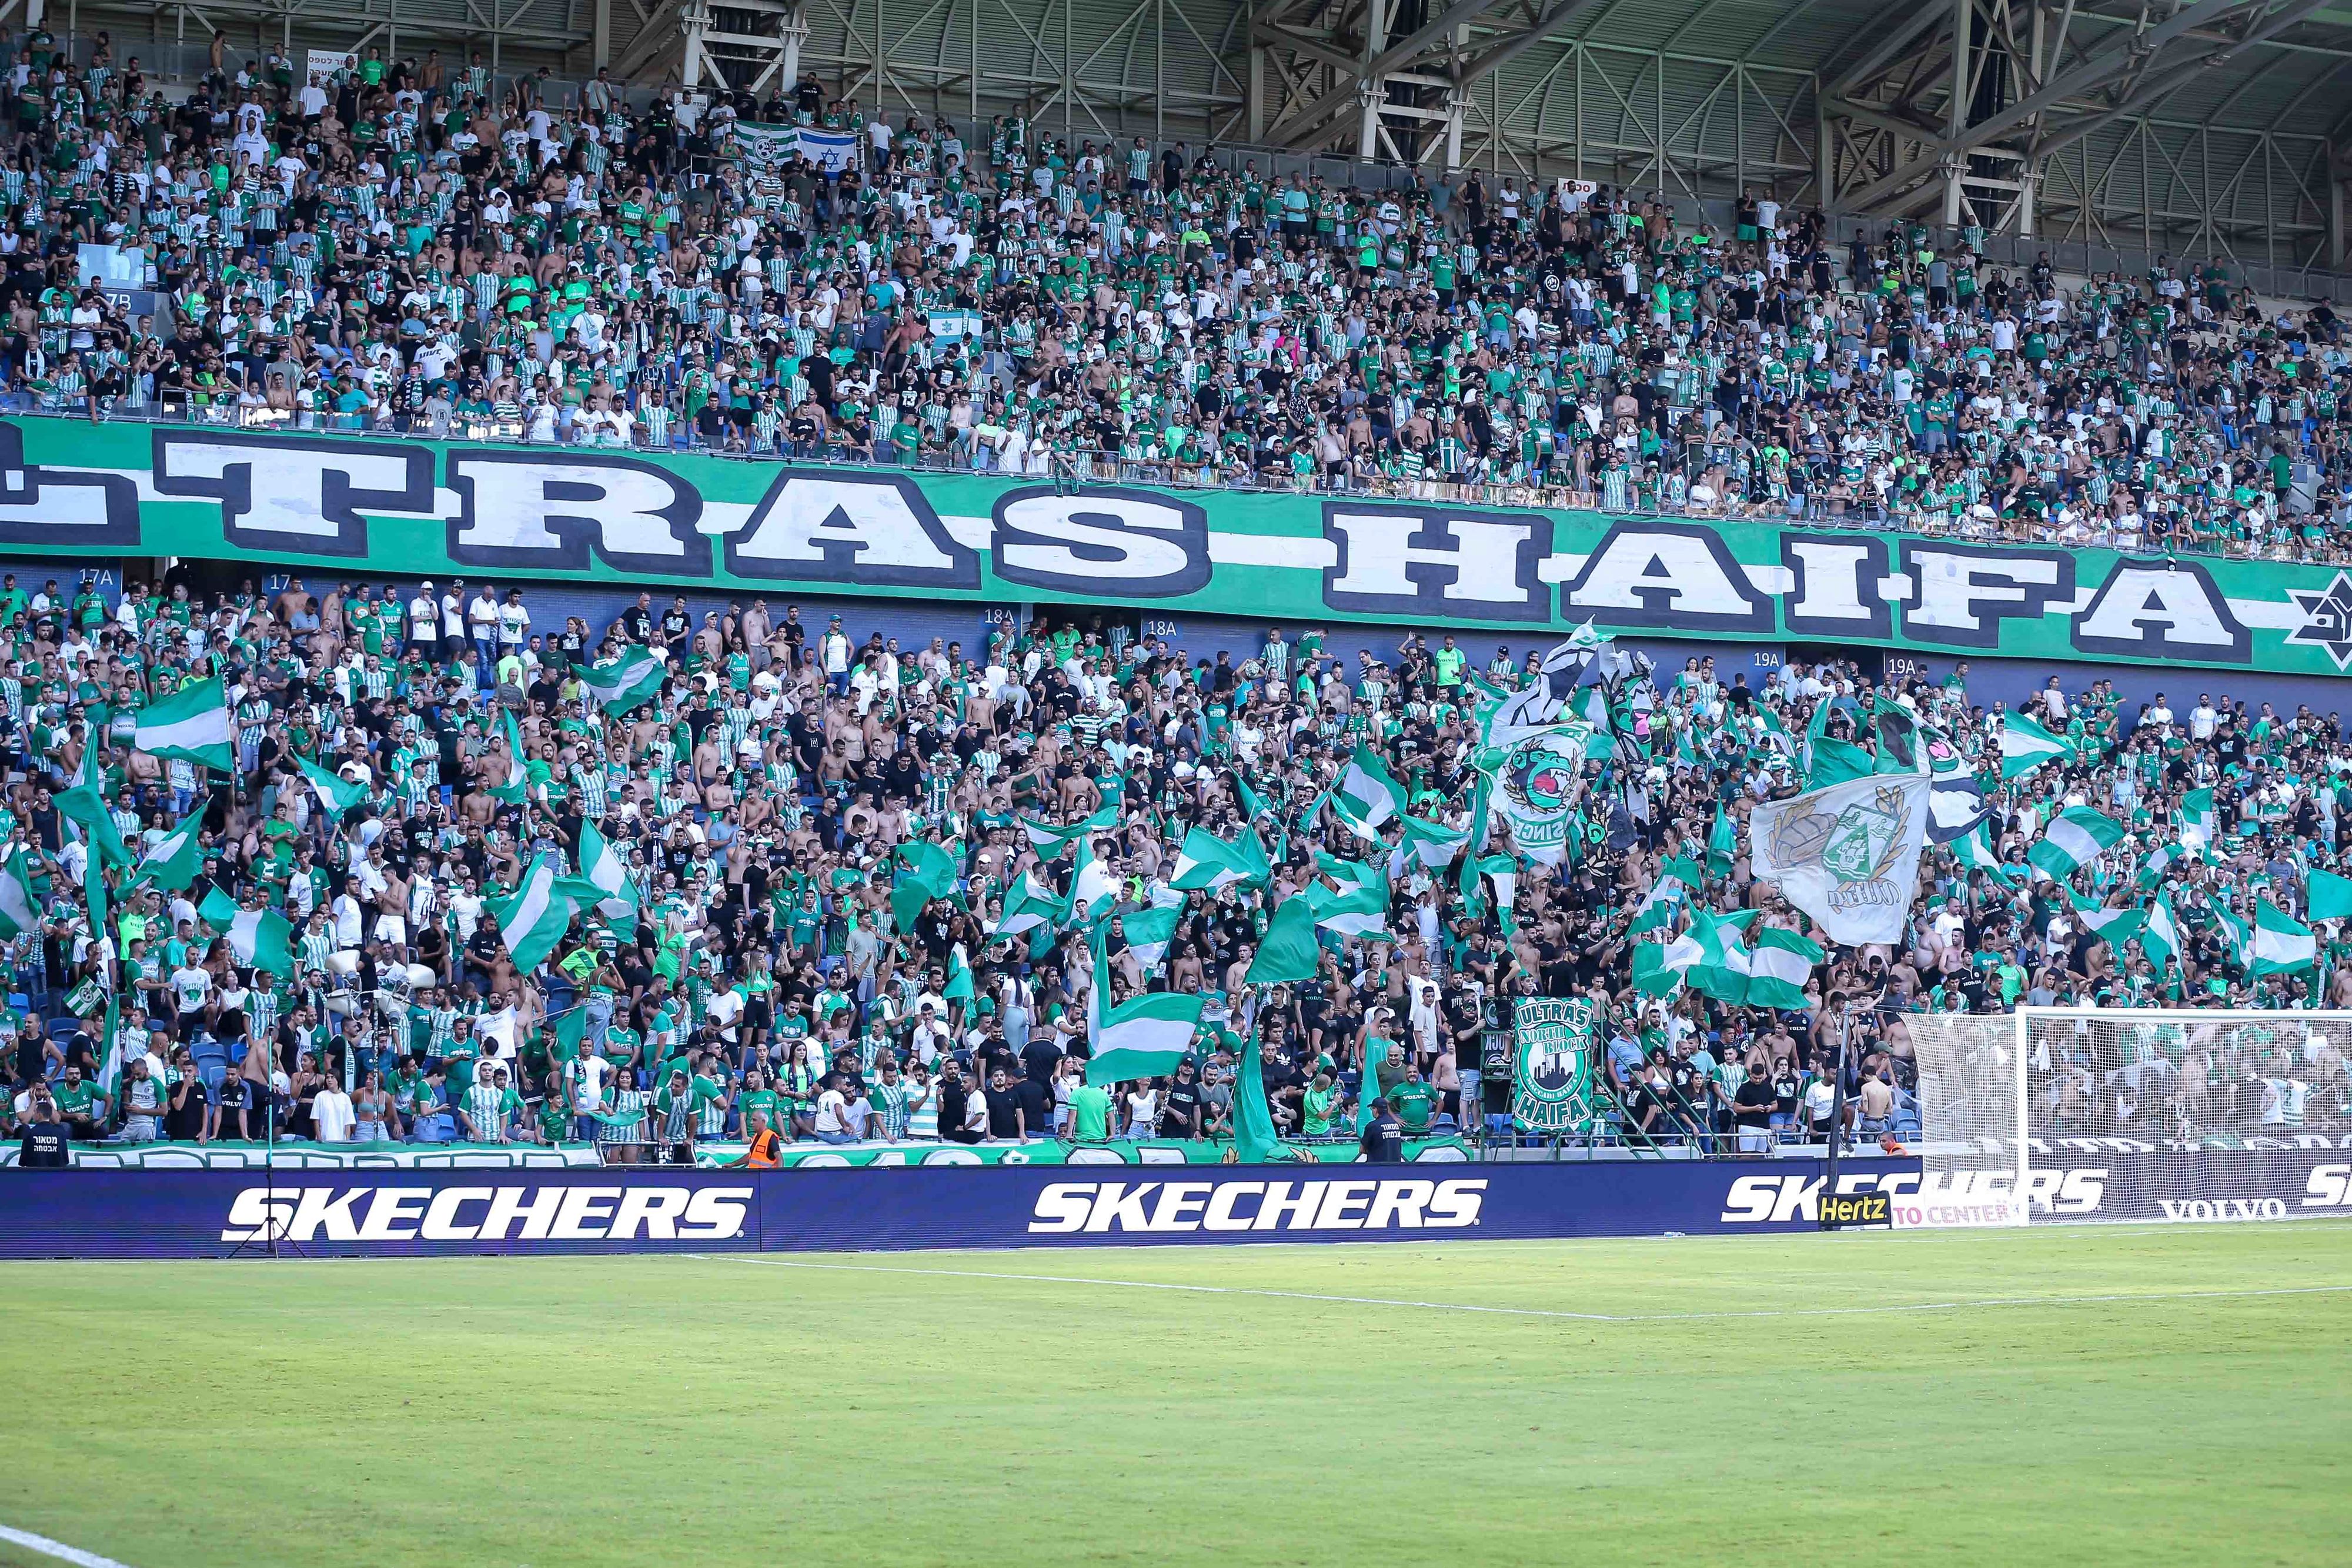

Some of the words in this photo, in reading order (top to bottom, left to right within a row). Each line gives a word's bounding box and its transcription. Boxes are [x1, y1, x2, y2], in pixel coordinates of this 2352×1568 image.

[1614, 255, 1623, 268] 13
[106, 293, 132, 310] 7B
[79, 569, 113, 586] 17A
[1322, 502, 2252, 664] HAIFA
[638, 623, 650, 636] 13
[1147, 620, 1177, 636] 18A
[1753, 652, 1780, 667] 19A
[1889, 659, 1916, 674] 19A
[1517, 1000, 1591, 1026] ULTRAS
[1519, 1025, 1565, 1044] NORTH
[1544, 1035, 1586, 1055] BLOCK
[66, 1103, 91, 1113] VOLVO
[1516, 1094, 1590, 1127] HAIFA
[33, 1135, 58, 1145] מטאור
[34, 1144, 58, 1152] אבטחה
[221, 1186, 754, 1242] SKECHERS
[1028, 1179, 1488, 1233] SKECHERS
[1820, 1196, 1887, 1221] Hertz
[2156, 1198, 2287, 1220] VOLVO
